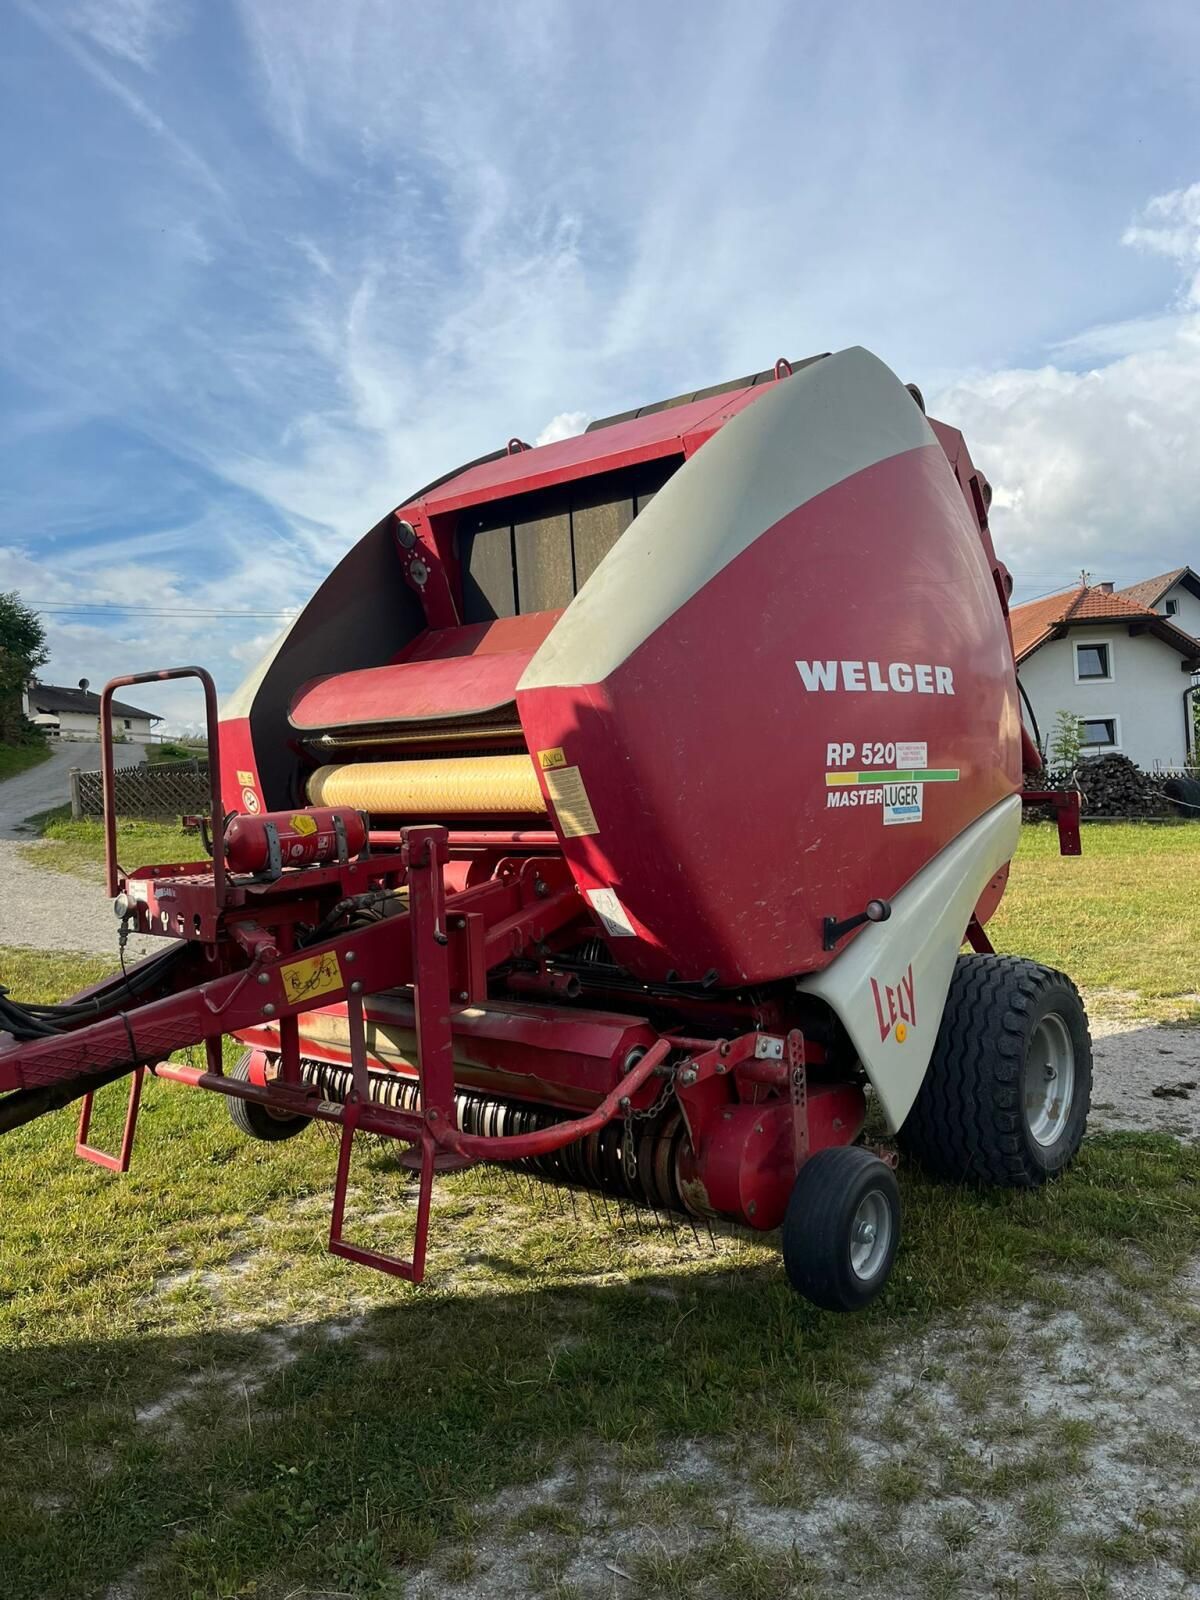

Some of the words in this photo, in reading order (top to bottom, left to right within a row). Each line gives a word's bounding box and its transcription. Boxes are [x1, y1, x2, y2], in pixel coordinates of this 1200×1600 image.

[795, 660, 955, 695] WELGER
[826, 743, 856, 766] RP
[861, 742, 896, 765] 520
[827, 789, 883, 808] MASTER
[884, 785, 918, 807] LUGER
[870, 963, 916, 1043] LELY
